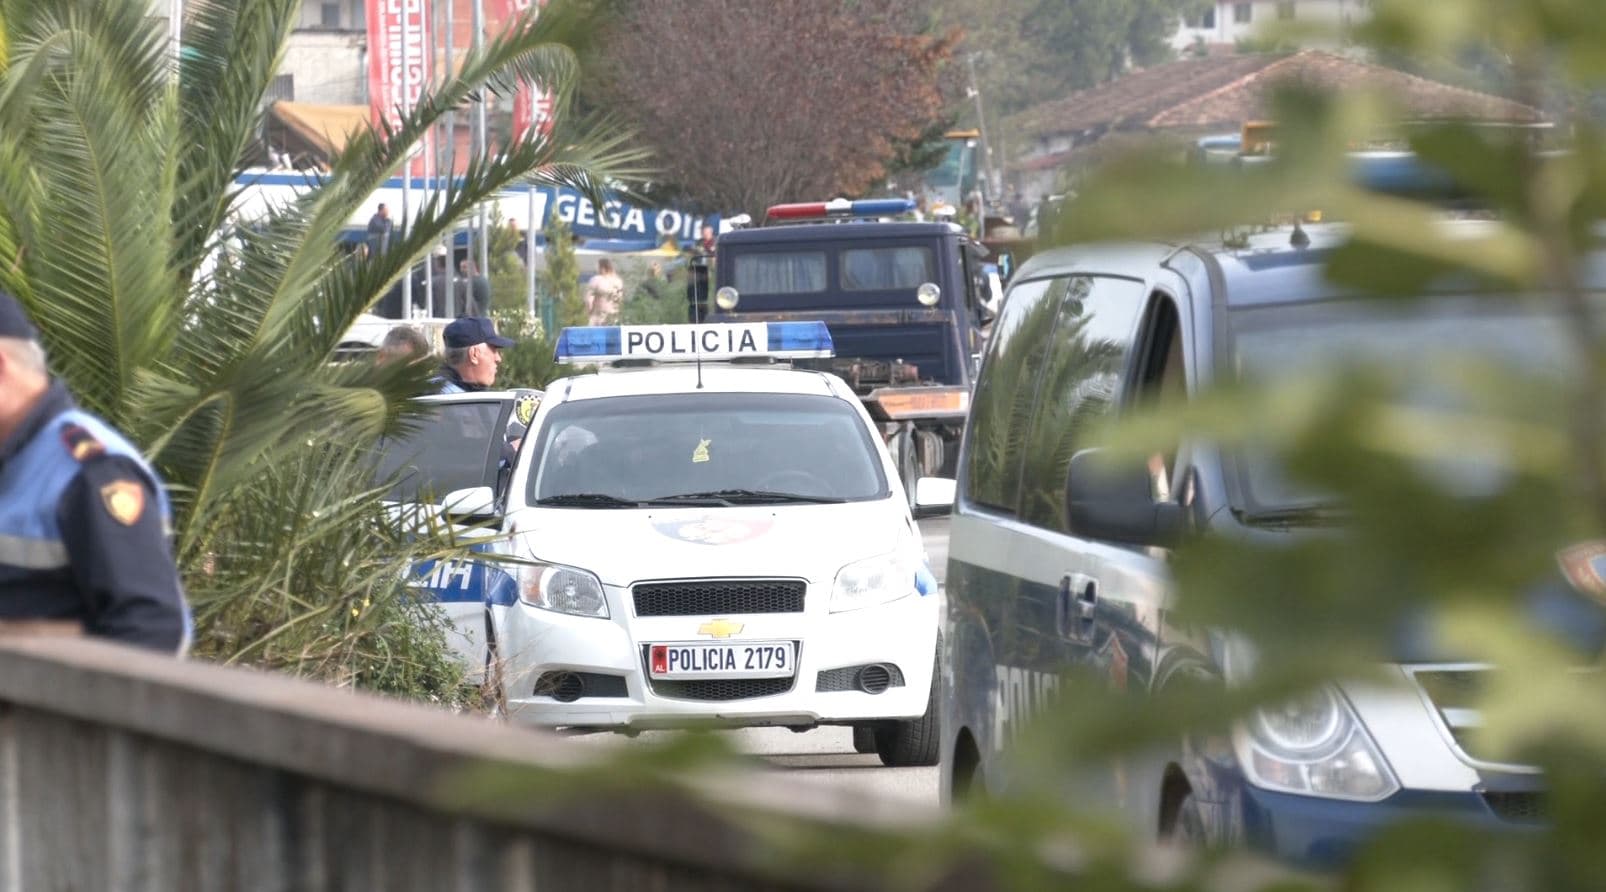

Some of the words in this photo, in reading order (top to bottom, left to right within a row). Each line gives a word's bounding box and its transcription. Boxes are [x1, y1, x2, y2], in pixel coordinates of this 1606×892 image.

[556, 193, 646, 234] GEGA
[627, 328, 757, 354] POLICIA
[655, 664, 666, 673] AL
[668, 647, 737, 672] POLICIA
[744, 646, 786, 671] 2179
